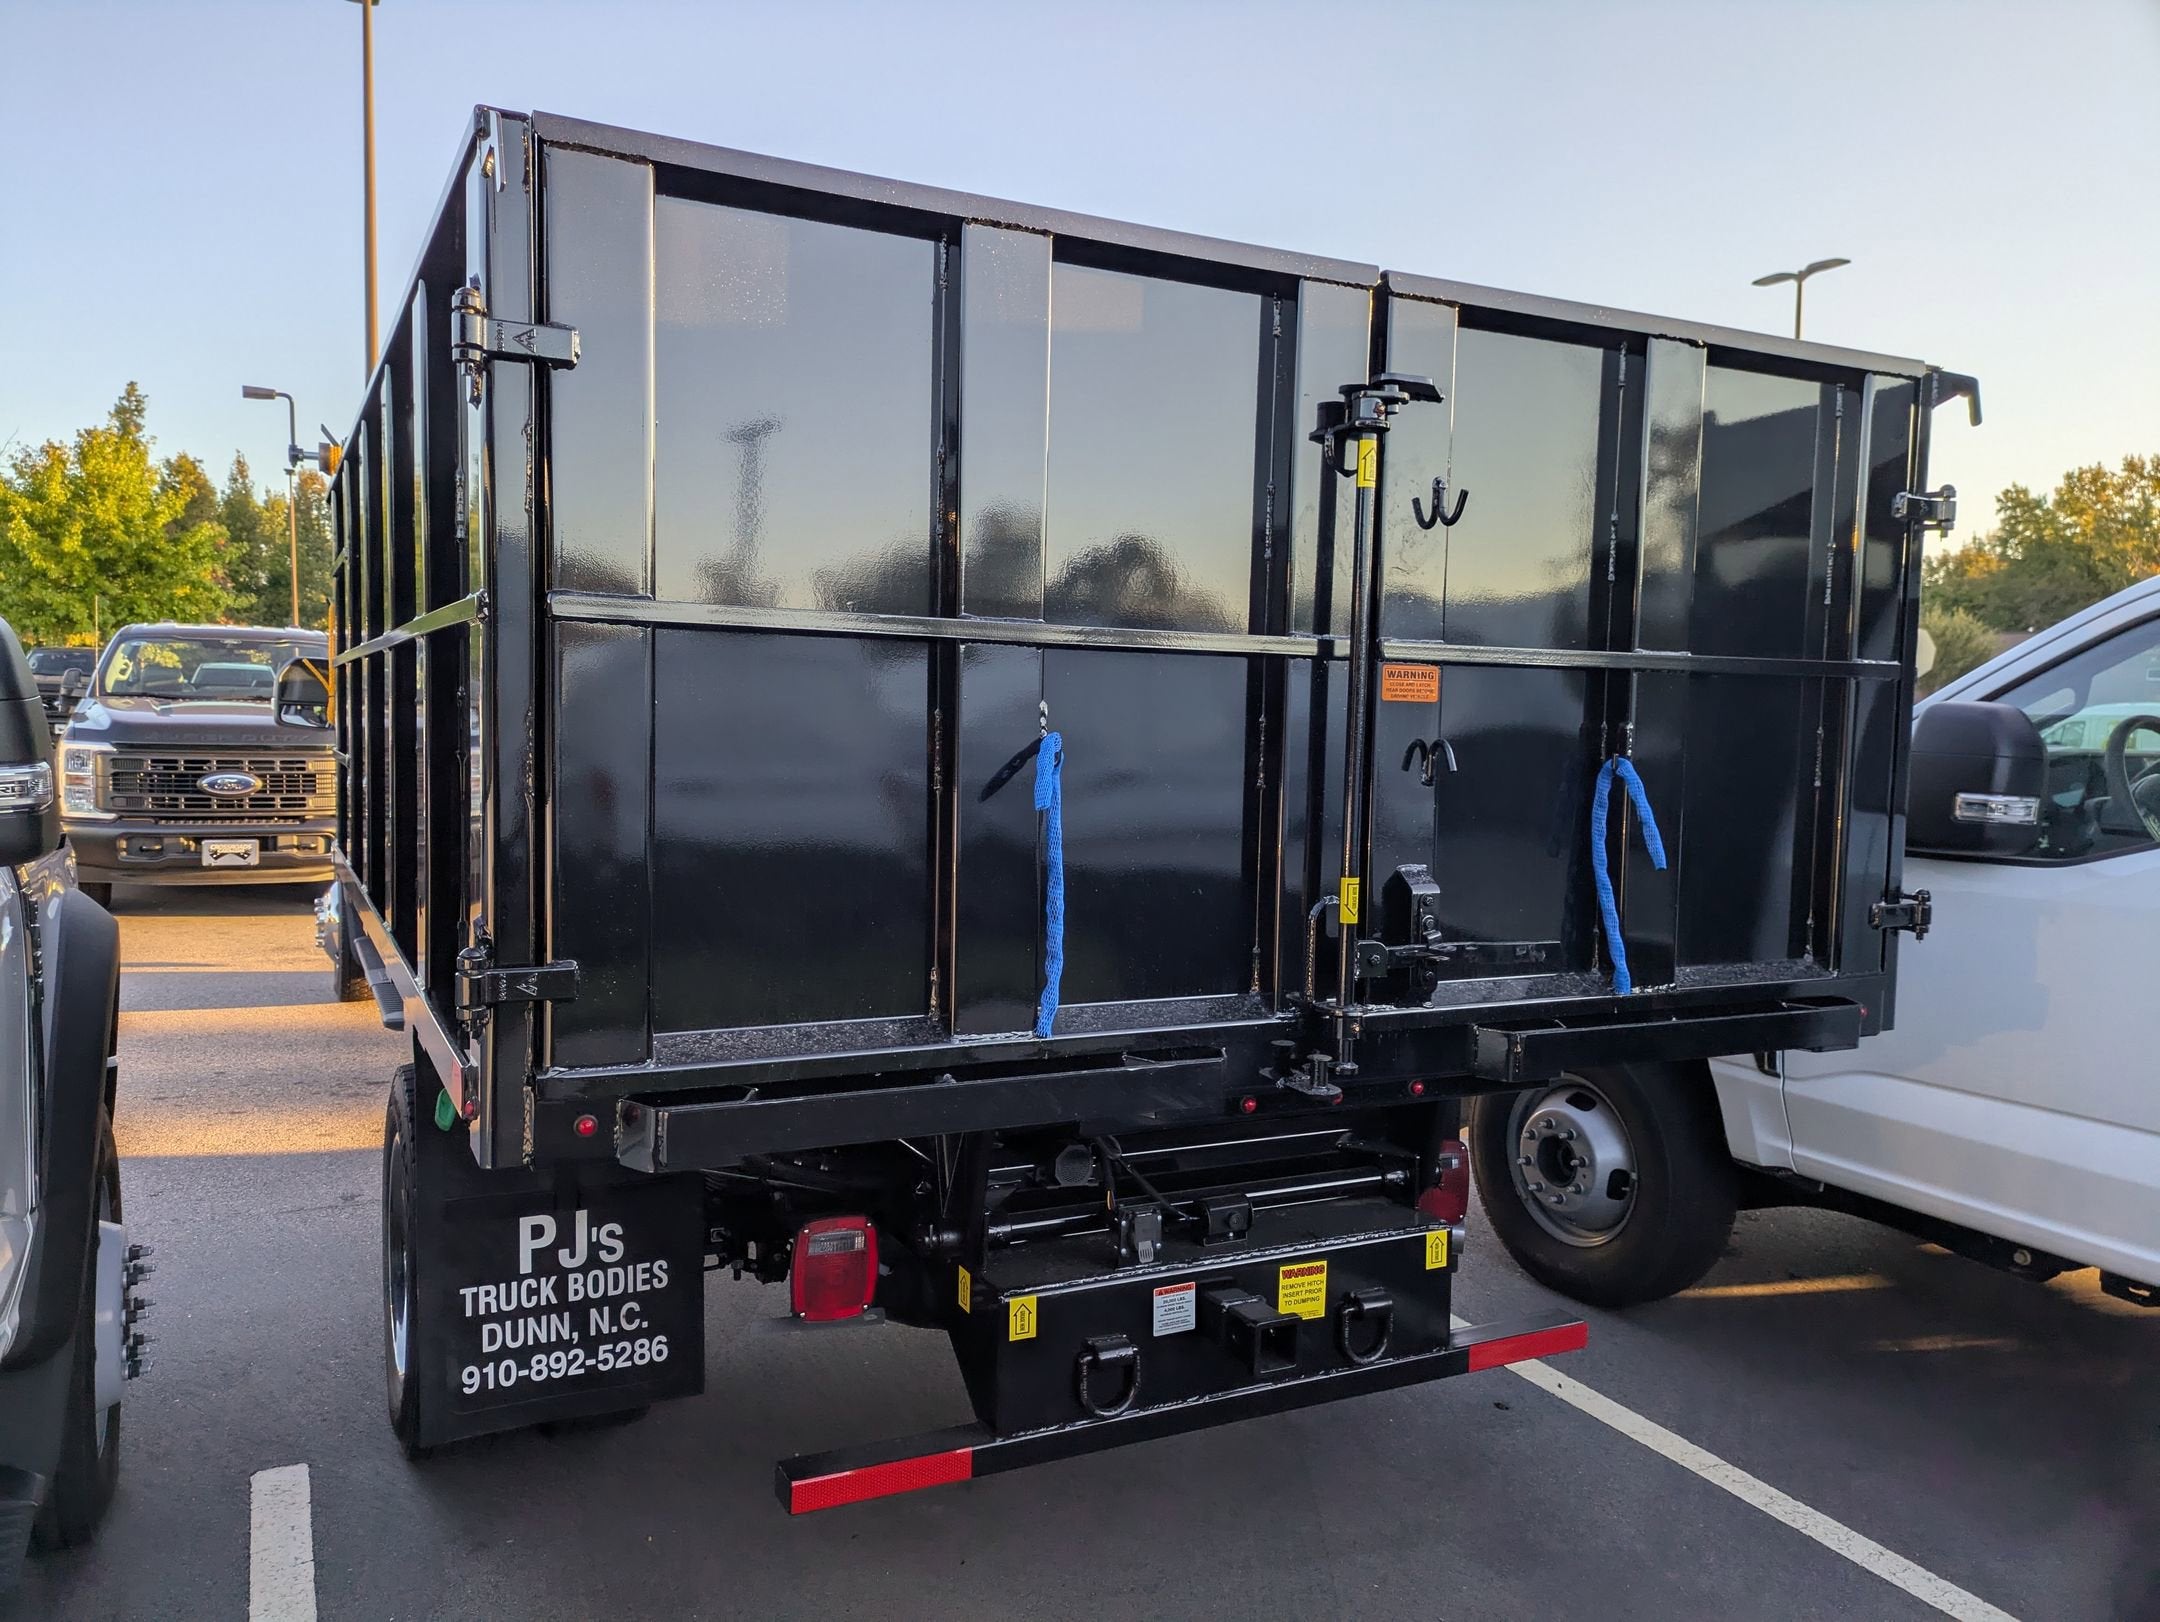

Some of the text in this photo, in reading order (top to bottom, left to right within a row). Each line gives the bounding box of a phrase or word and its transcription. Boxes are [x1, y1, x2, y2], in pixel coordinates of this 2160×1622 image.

[1387, 670, 1435, 680] WARNING
[1281, 1264, 1325, 1280] WARNING
[459, 1259, 669, 1318] TRUCK BODIES
[1164, 1284, 1192, 1294] WARNING
[1281, 1280, 1325, 1291] REMOVE HITCH
[1282, 1290, 1304, 1299] INSERT
[1294, 1296, 1320, 1305] DUMPING
[482, 1301, 649, 1353] DUNN, N.C.
[461, 1335, 669, 1395] 910-892-5286
